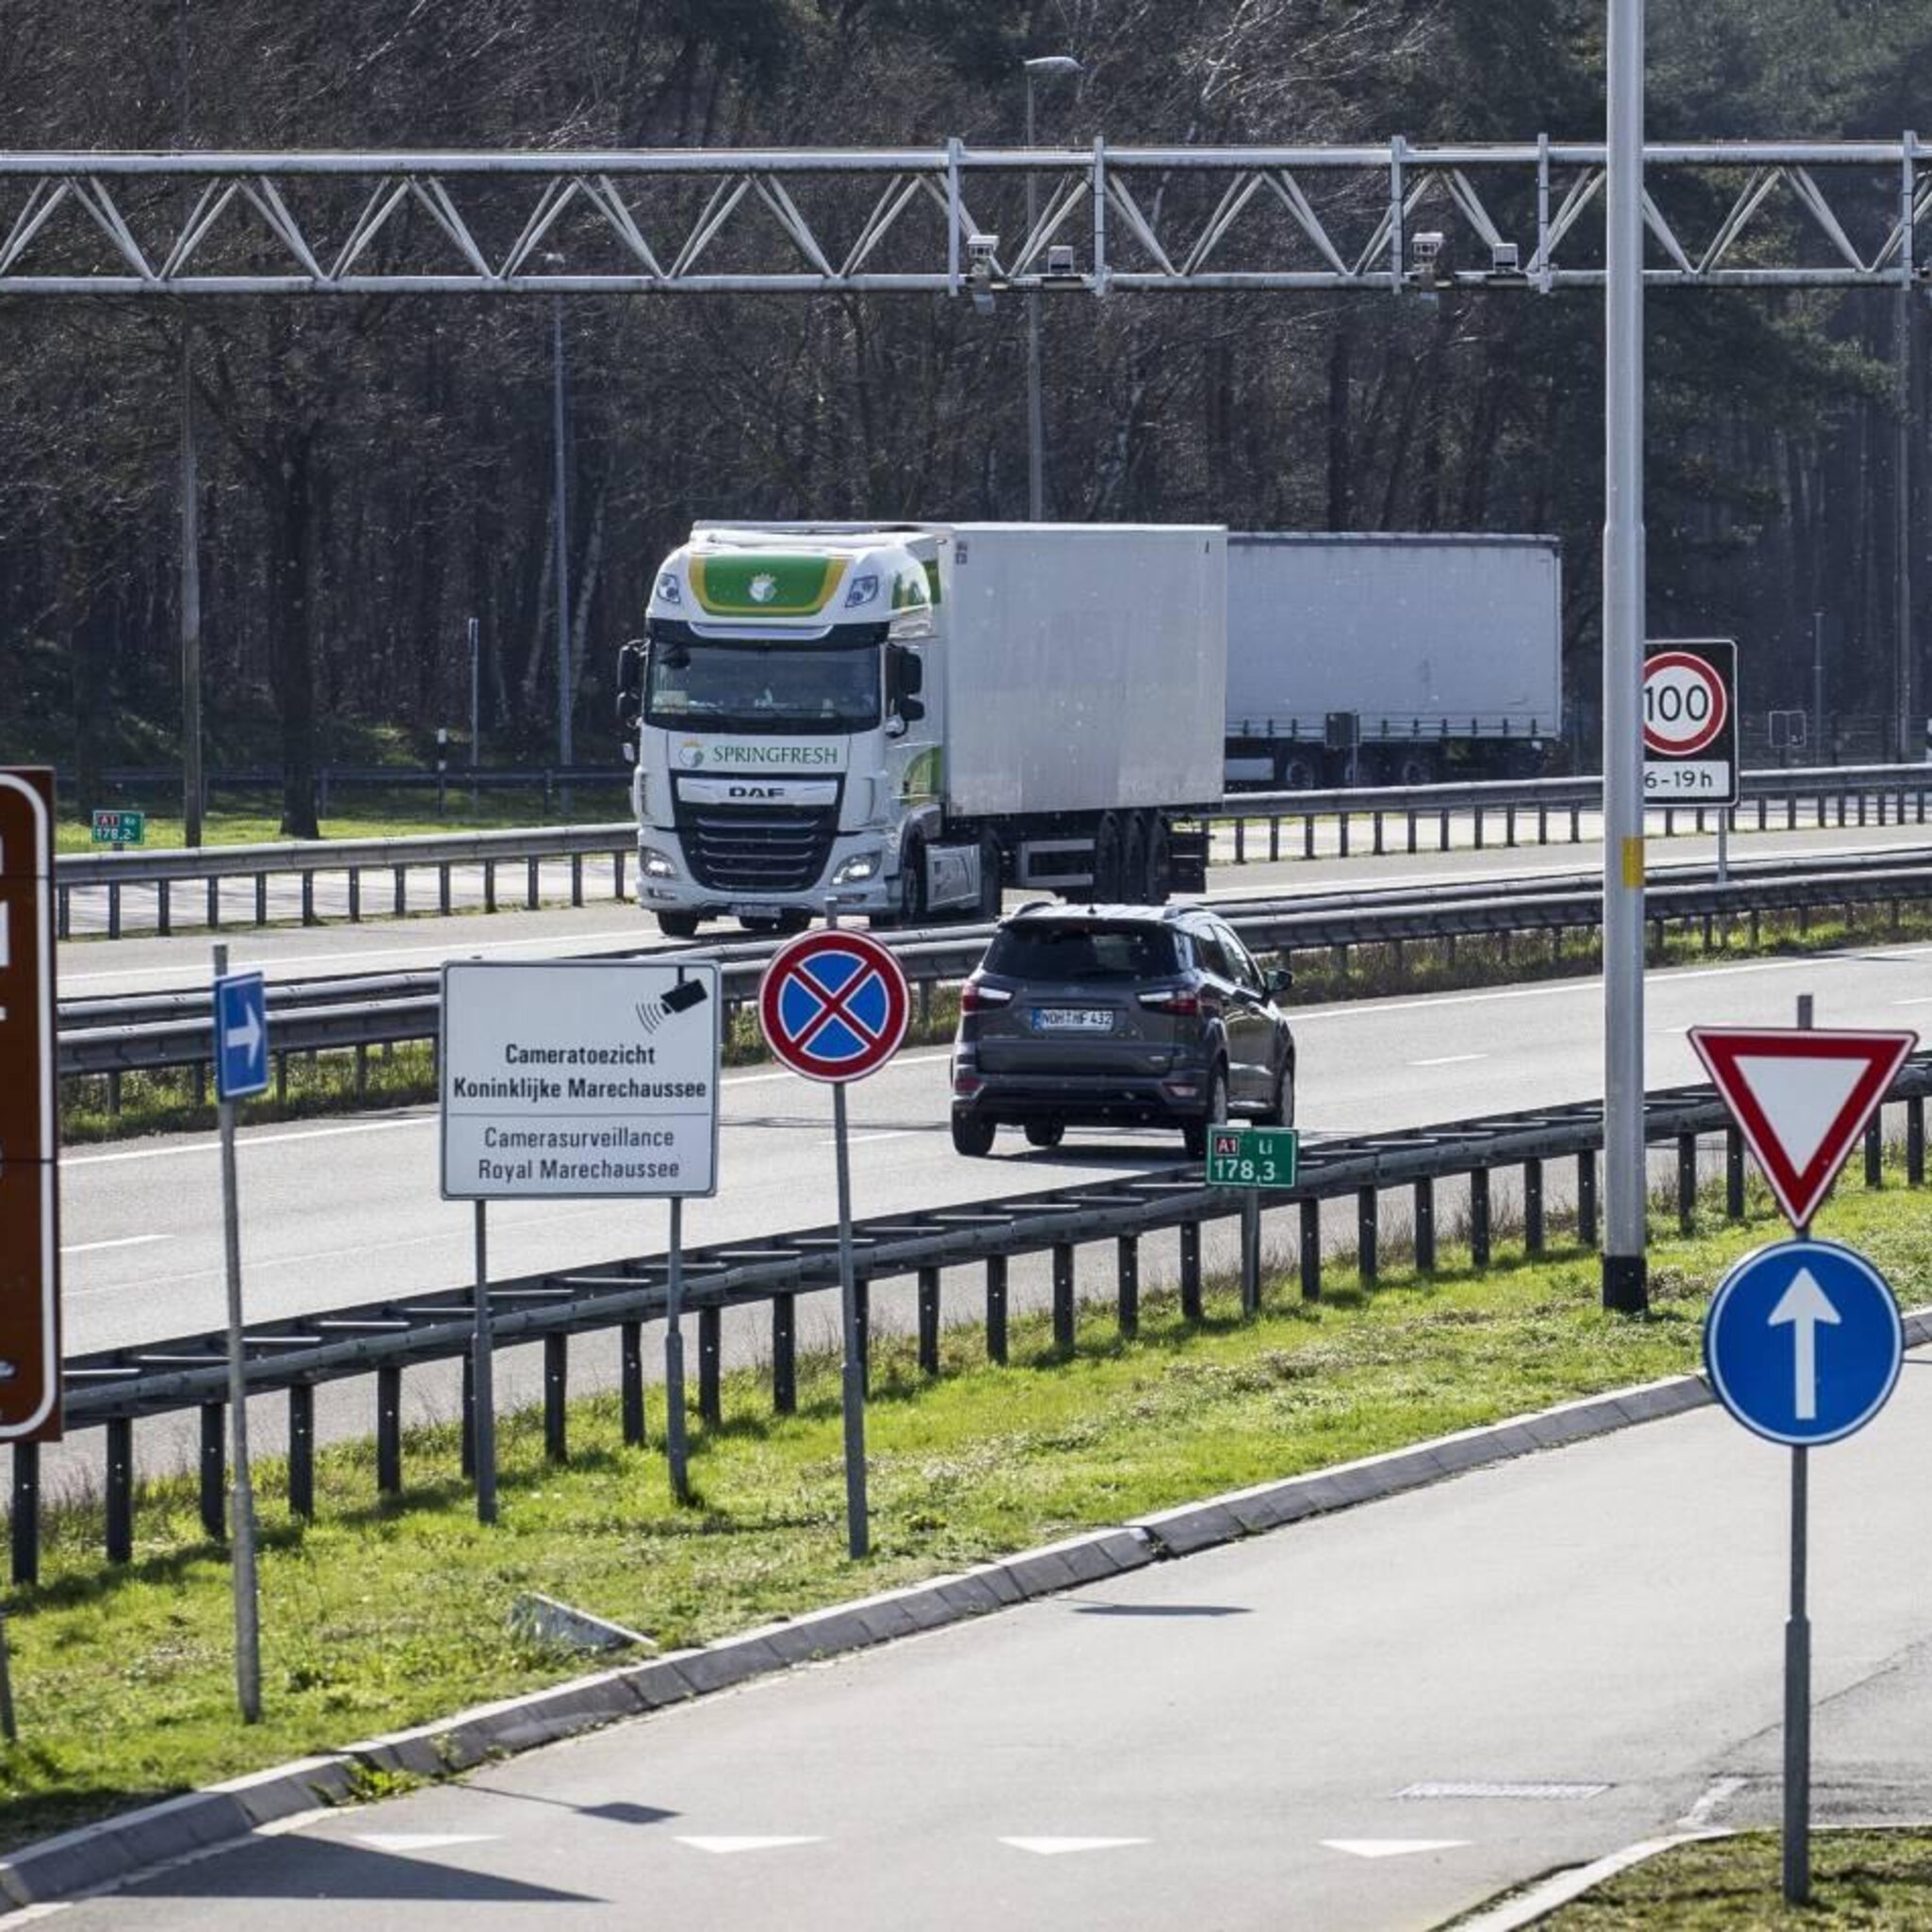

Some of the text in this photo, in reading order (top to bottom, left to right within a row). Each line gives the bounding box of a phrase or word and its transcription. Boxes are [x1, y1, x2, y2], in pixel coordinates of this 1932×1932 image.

[1644, 685, 1707, 722] 100
[713, 744, 838, 764] SPRINGFRESH
[1644, 772, 1695, 789] 6-19
[728, 787, 786, 798] DAF
[100, 815, 115, 824] A1
[505, 1043, 656, 1065] Cameratoezicht
[454, 1077, 707, 1103] Koninklijke Marechaussee
[484, 1127, 675, 1148] Camerasurveillance
[1218, 1138, 1273, 1155] A1 Li
[478, 1159, 680, 1183] Royal Marechaussee
[1214, 1159, 1275, 1183] 178,3
